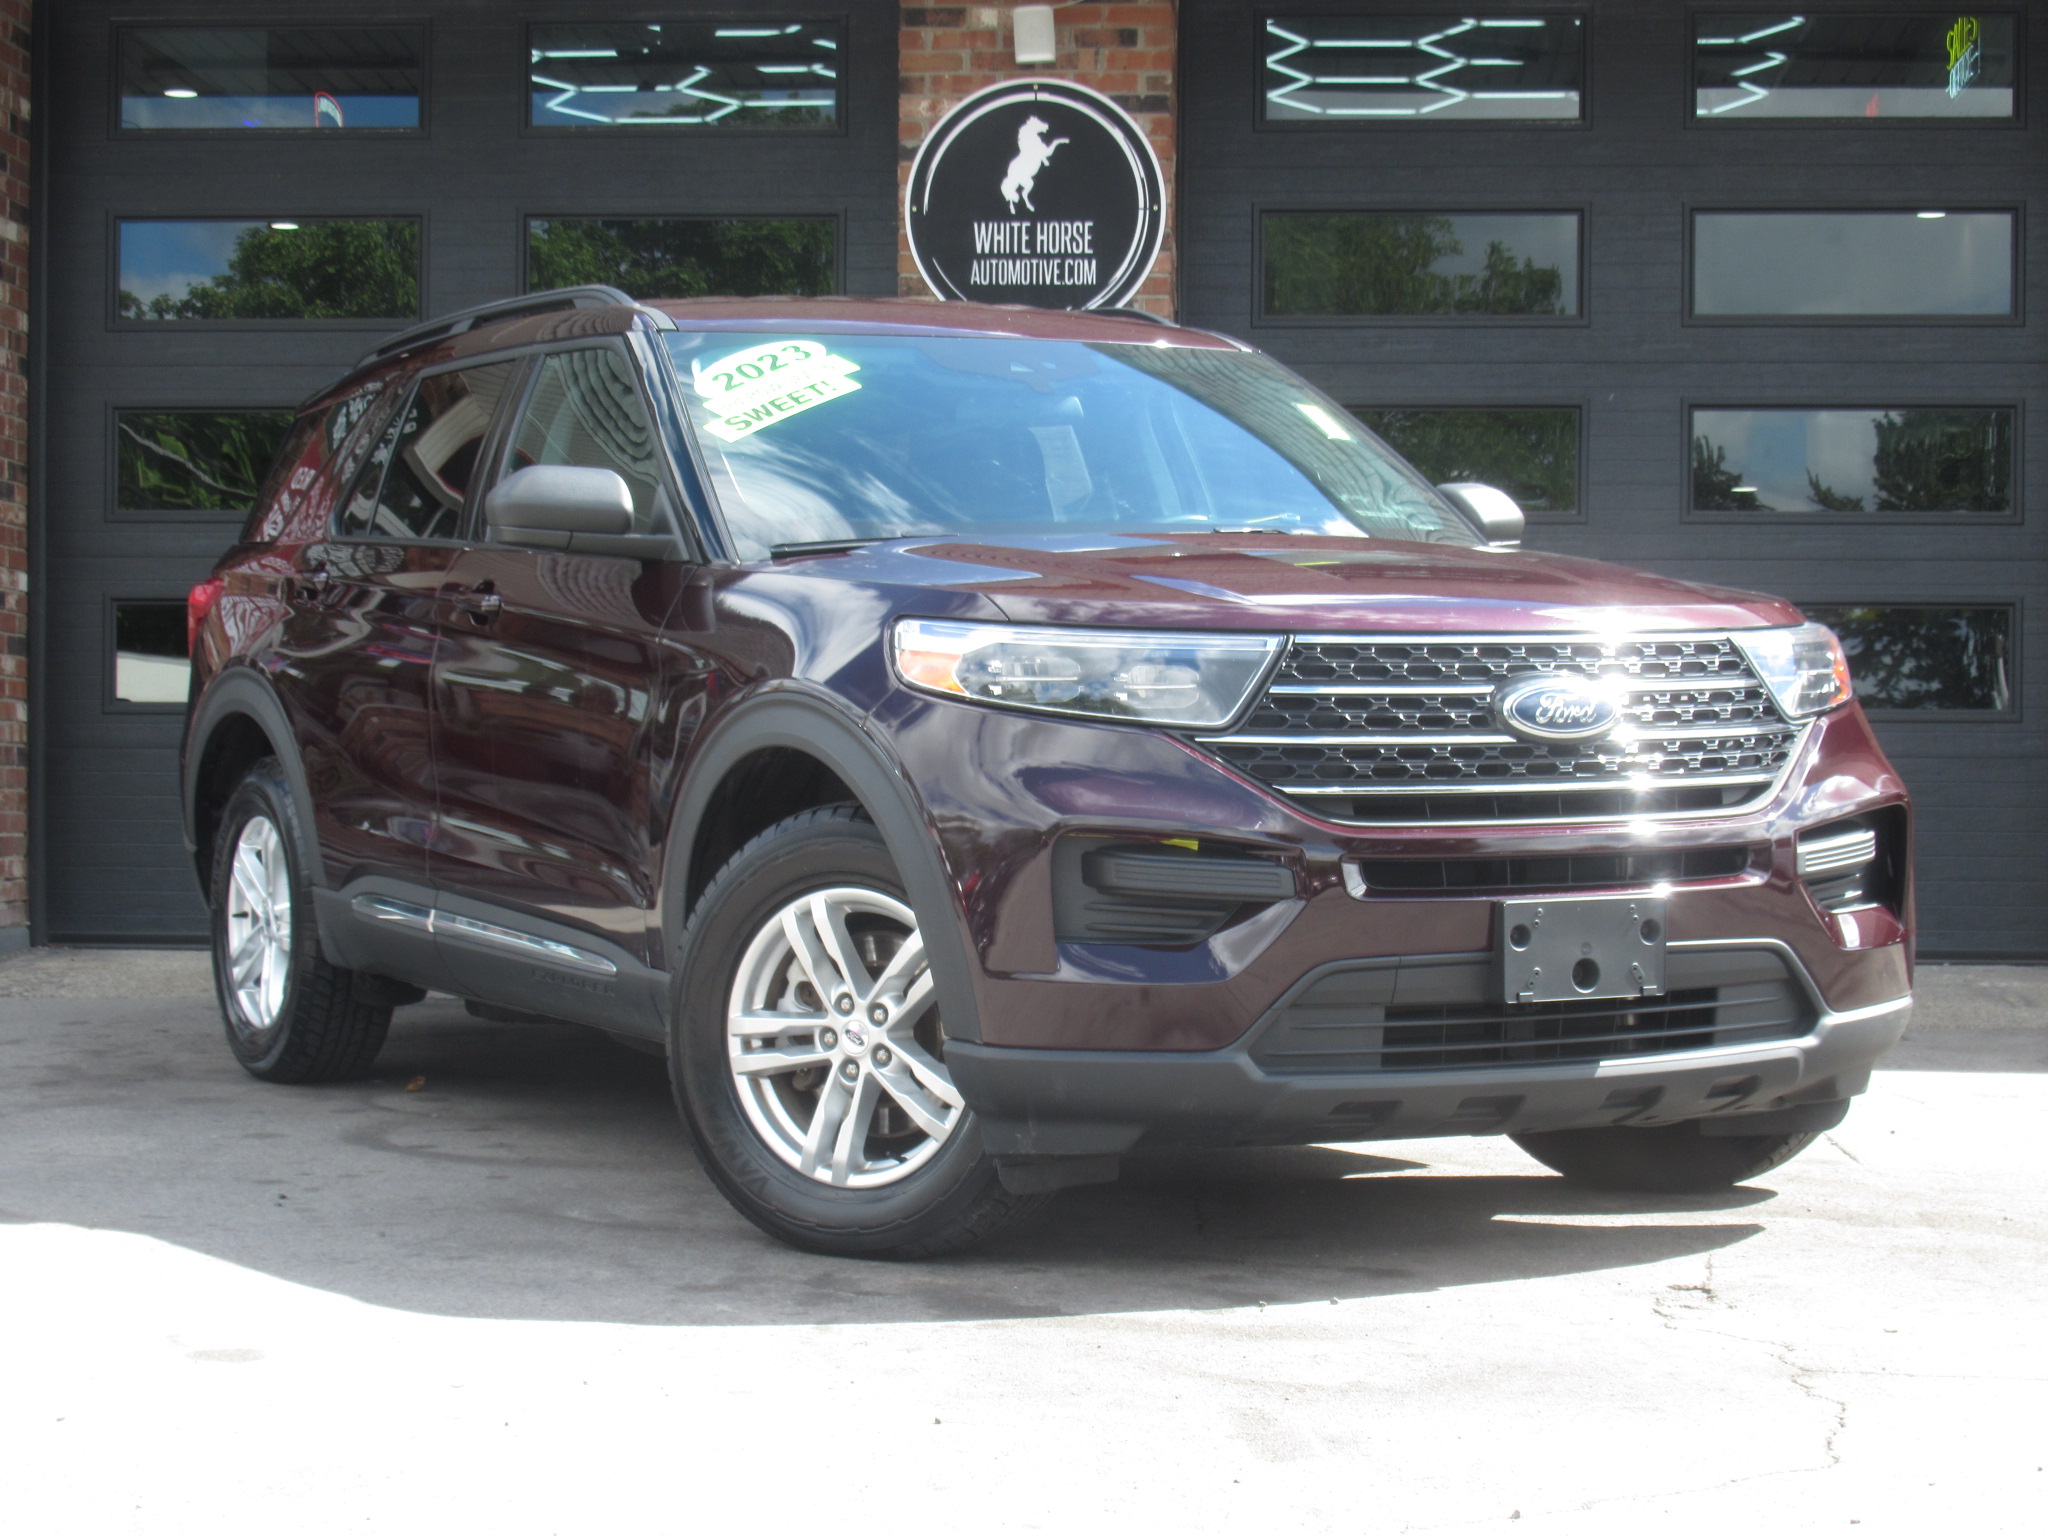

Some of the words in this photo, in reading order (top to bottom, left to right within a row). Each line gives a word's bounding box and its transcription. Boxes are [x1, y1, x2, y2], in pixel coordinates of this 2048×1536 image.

[973, 221, 1031, 254] WHITE
[1036, 221, 1094, 254] HORSE
[970, 258, 1096, 286] AUTOMOTIVE.COM
[711, 345, 812, 392] 2023
[724, 380, 837, 431] SWEET!
[1535, 691, 1597, 724] Ford
